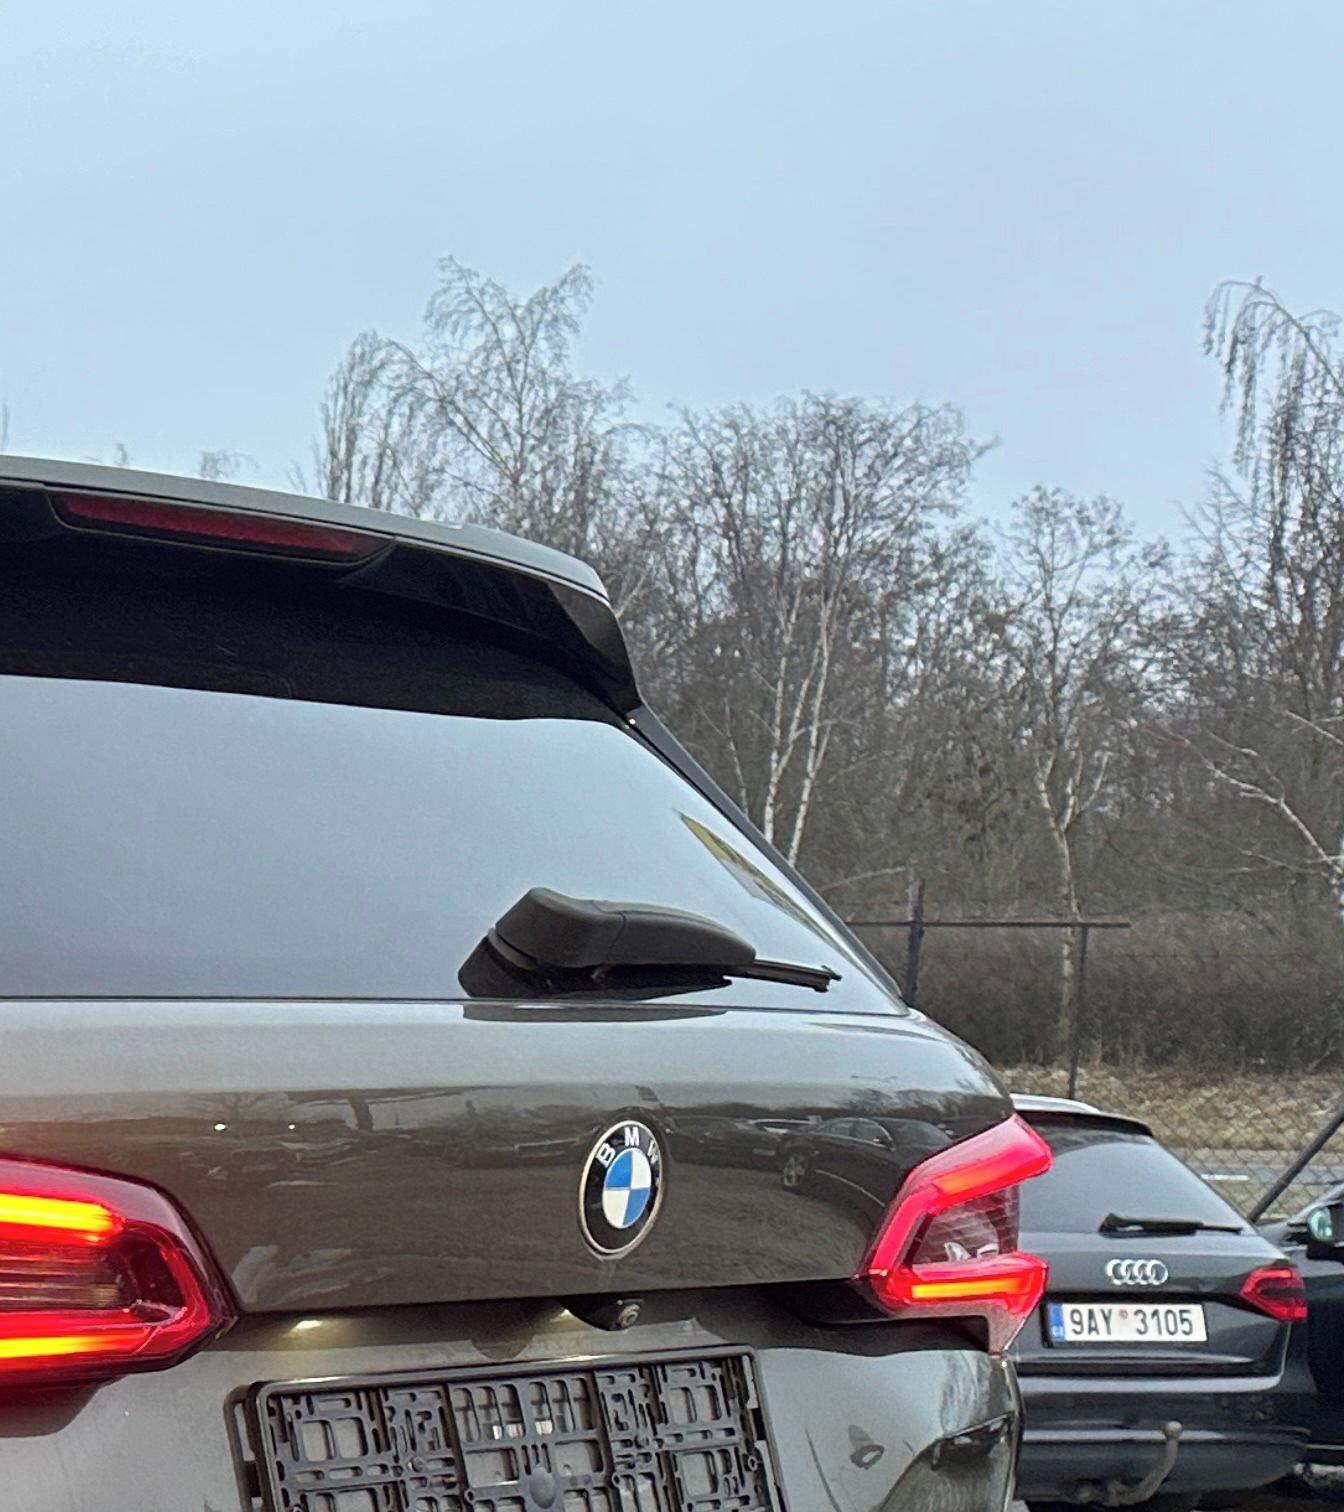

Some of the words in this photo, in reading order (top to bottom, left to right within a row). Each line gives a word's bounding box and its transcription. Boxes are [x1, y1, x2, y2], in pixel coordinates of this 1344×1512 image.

[596, 1126, 659, 1168] BMW
[1069, 1308, 1113, 1336] 9AY
[1133, 1308, 1194, 1336] 3105
